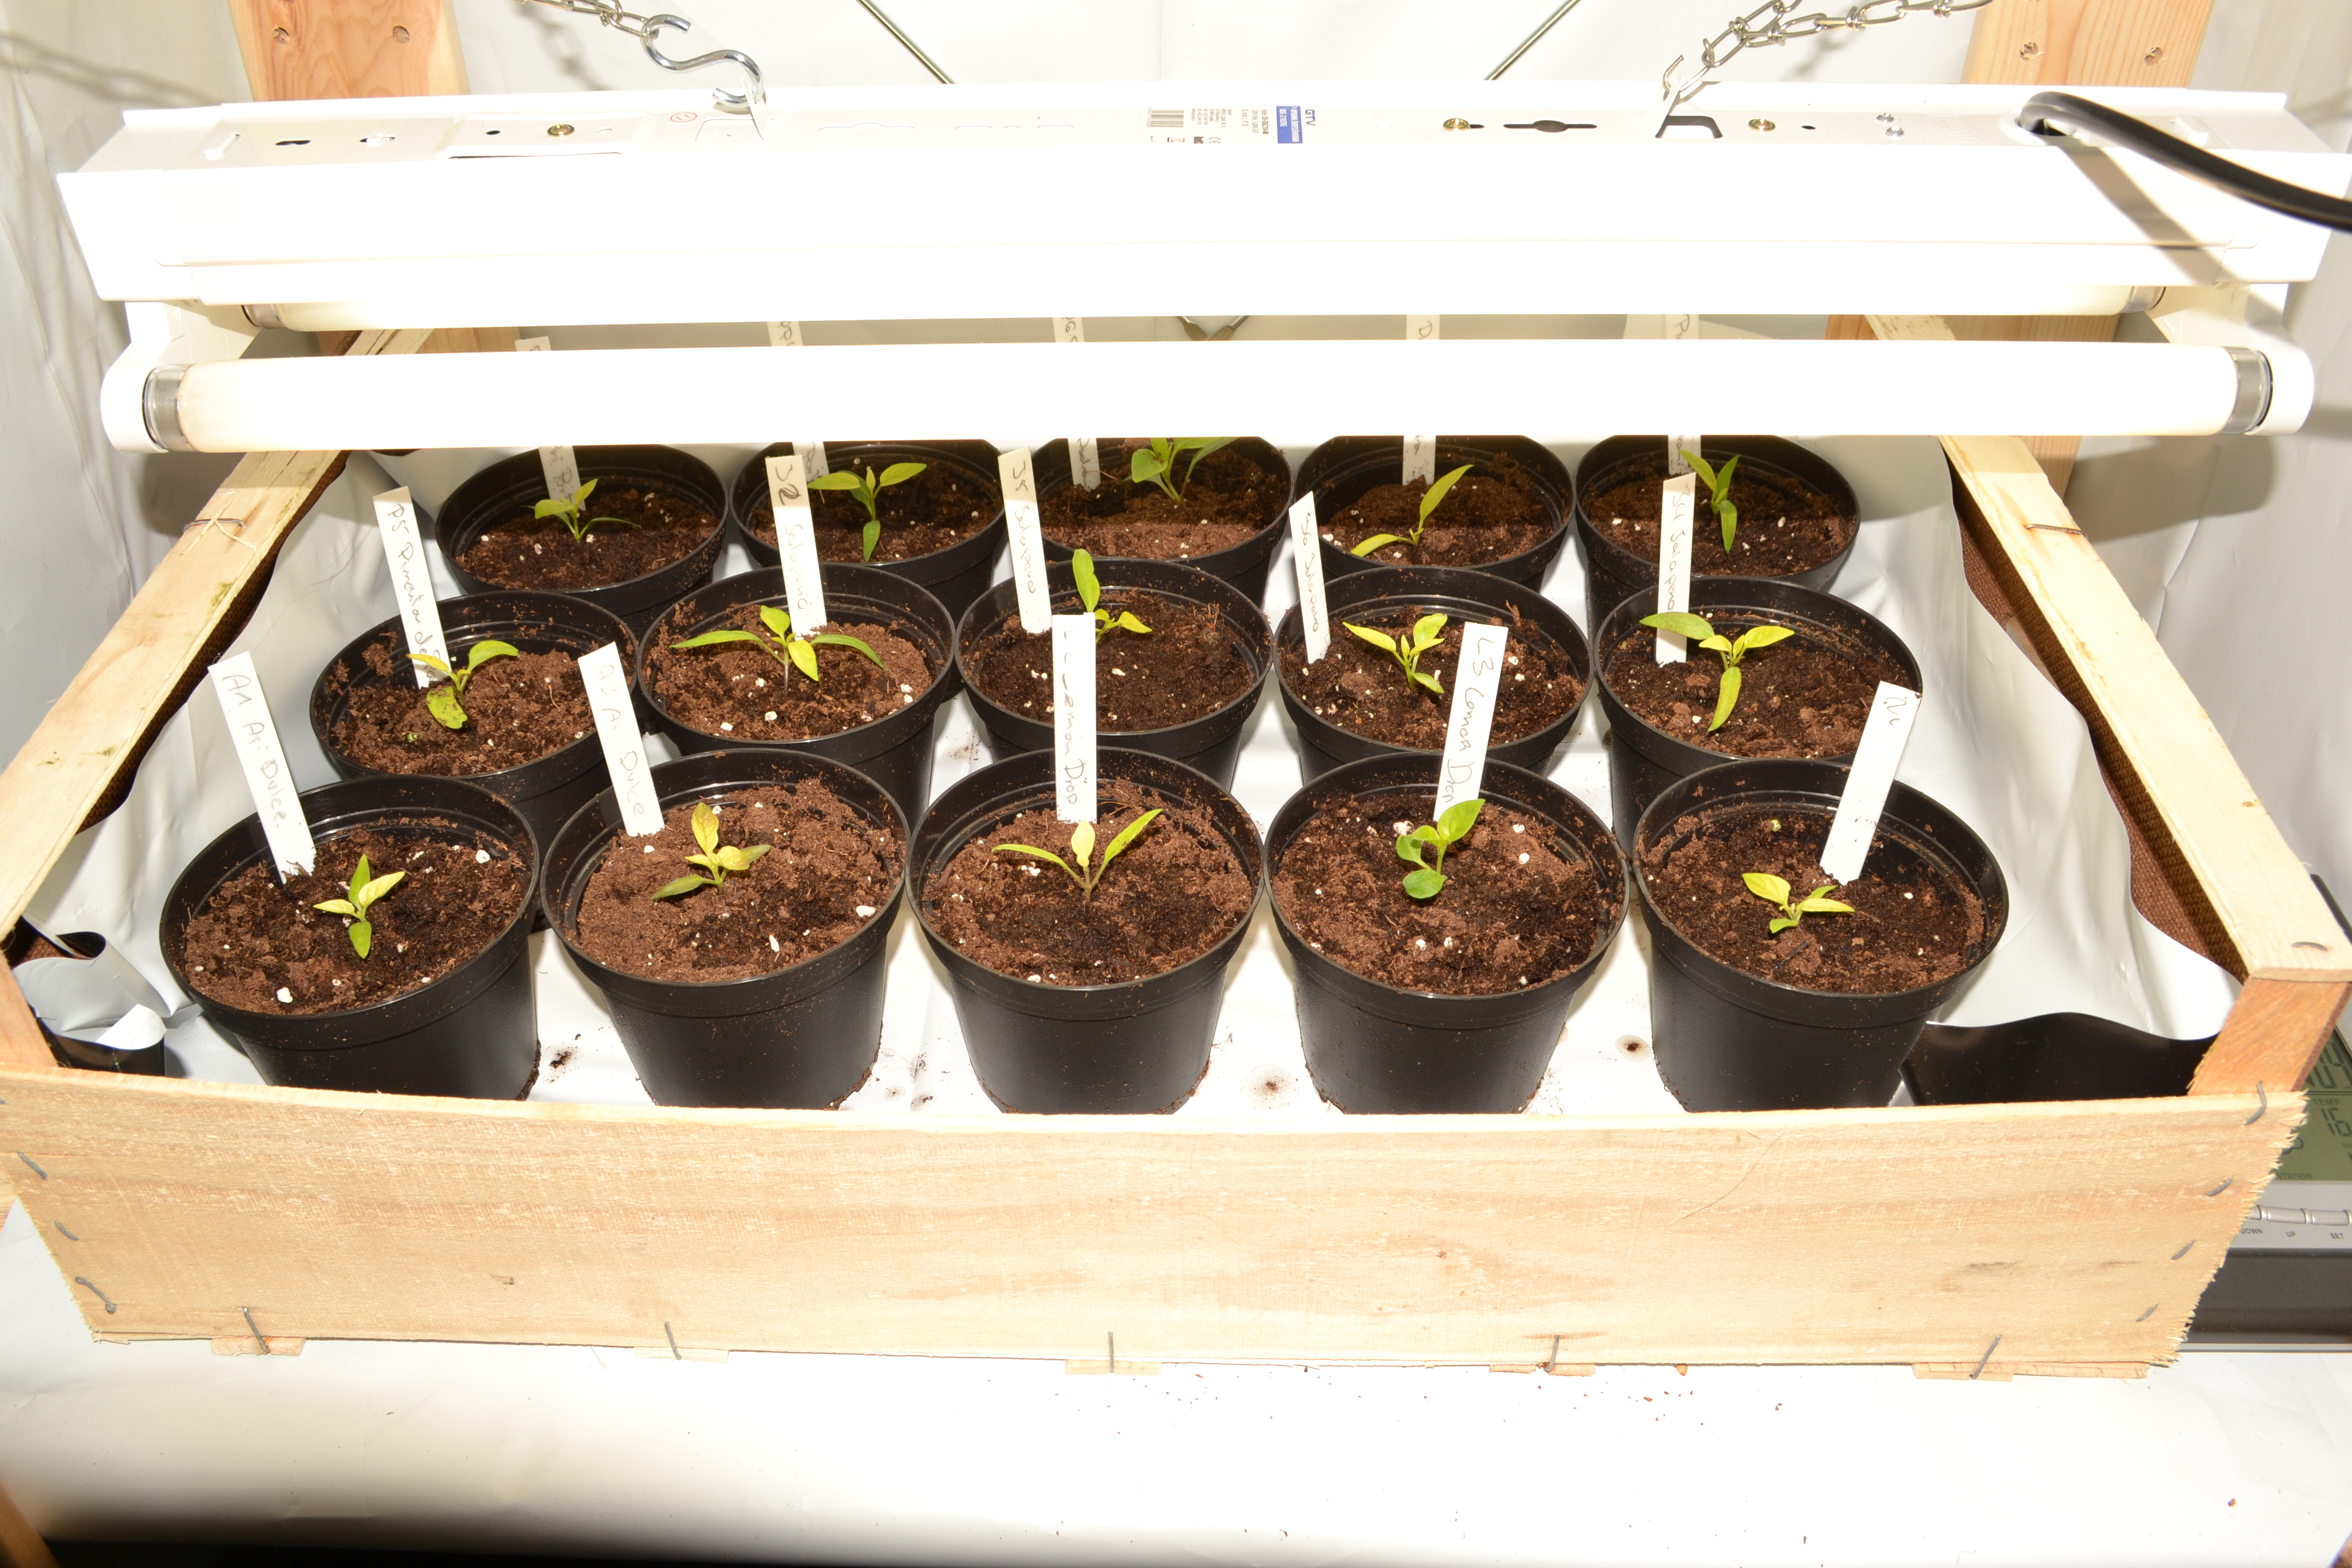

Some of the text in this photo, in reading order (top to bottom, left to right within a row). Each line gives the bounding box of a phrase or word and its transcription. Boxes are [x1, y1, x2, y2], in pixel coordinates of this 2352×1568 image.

[1305, 109, 1316, 126] GTV
[1472, 637, 1495, 677] L3
[259, 758, 289, 822] Dulce
[1063, 758, 1087, 805] Drop
